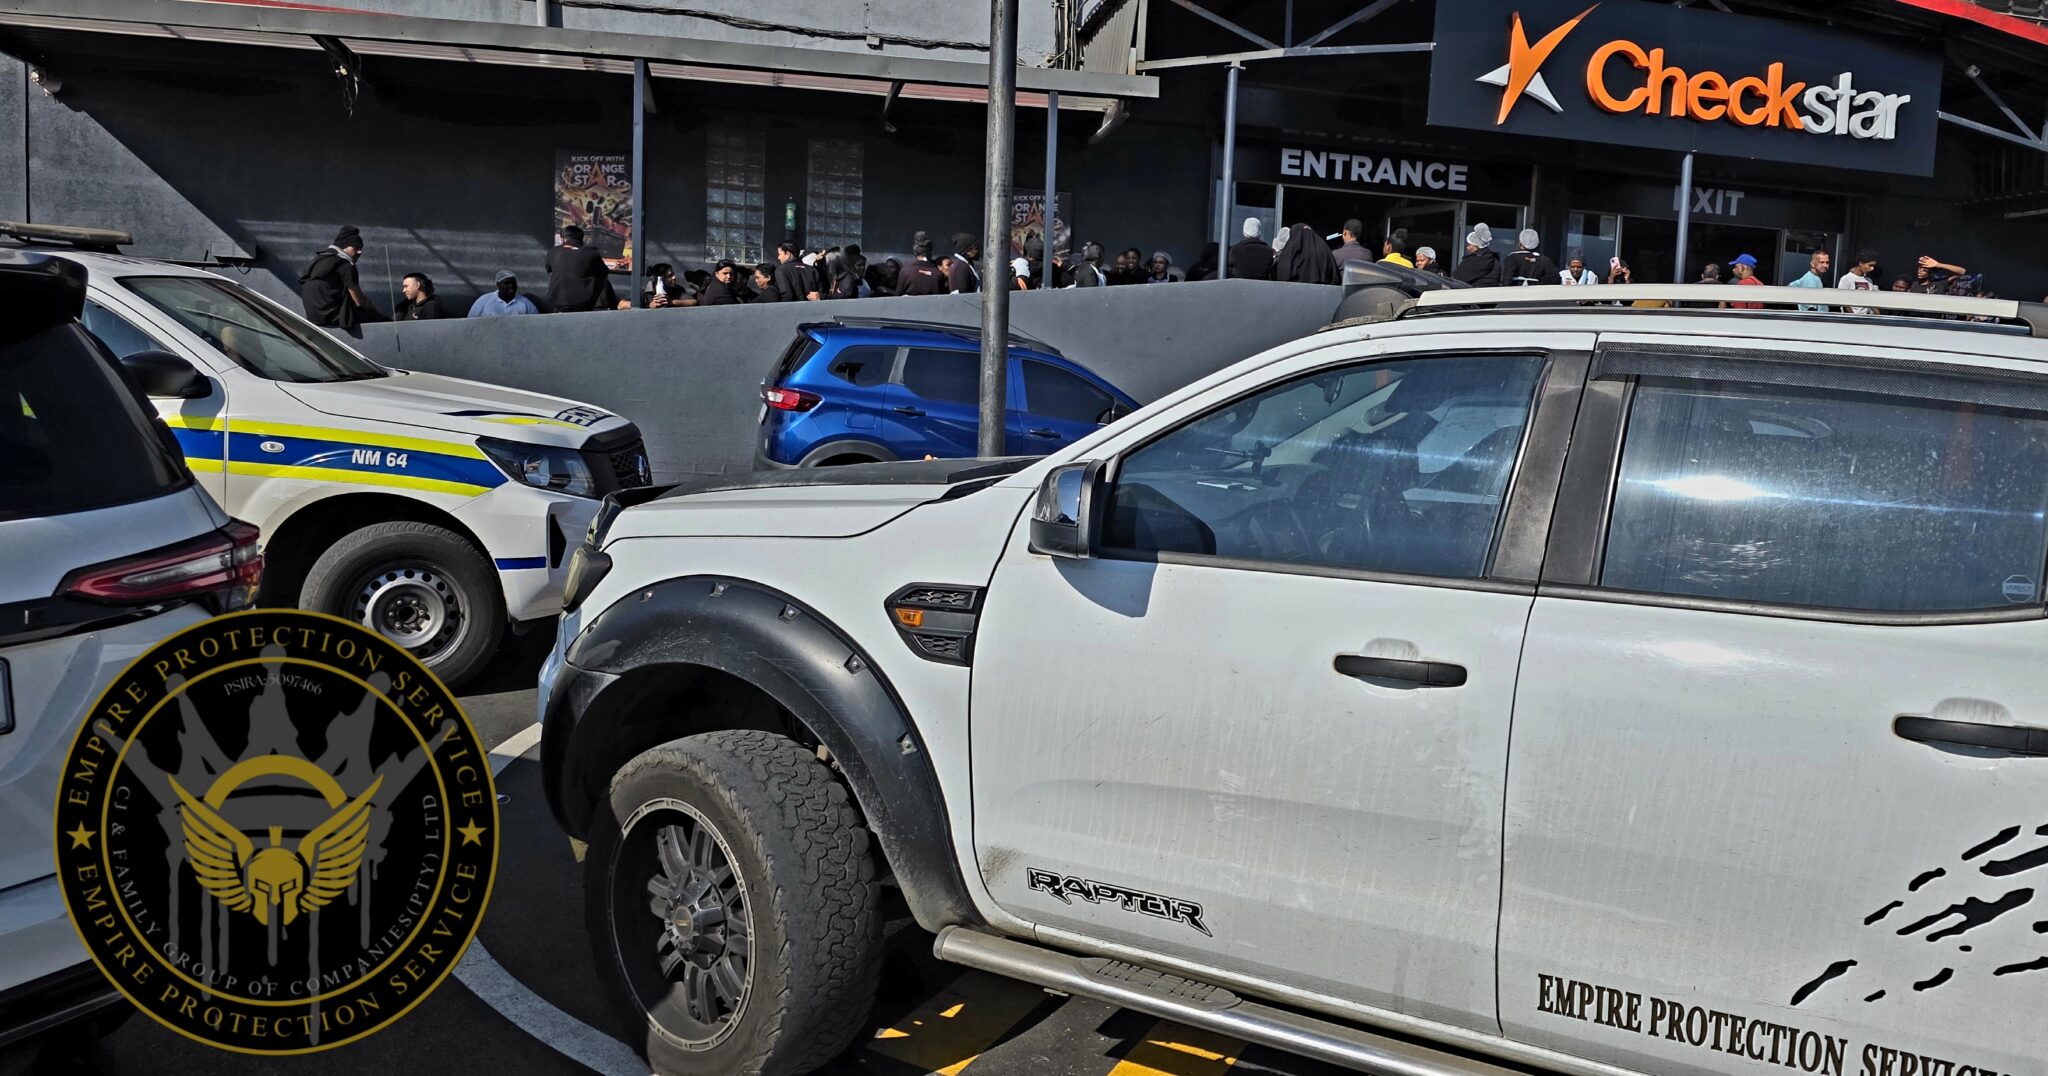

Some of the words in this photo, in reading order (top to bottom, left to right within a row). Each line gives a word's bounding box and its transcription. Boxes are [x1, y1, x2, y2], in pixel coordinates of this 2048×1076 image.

[1586, 39, 1911, 141] Checkstar
[573, 163, 625, 174] ORANGE
[1280, 148, 1468, 192] ENTRANCE
[1014, 202, 1059, 212] ORANE
[1015, 213, 1047, 223] STA
[351, 449, 380, 467] NM
[385, 451, 408, 468] 64
[1026, 867, 1213, 937] RAPTOR
[1537, 973, 1642, 1033] EMPIRE
[1648, 996, 1848, 1076] PROTECTION
